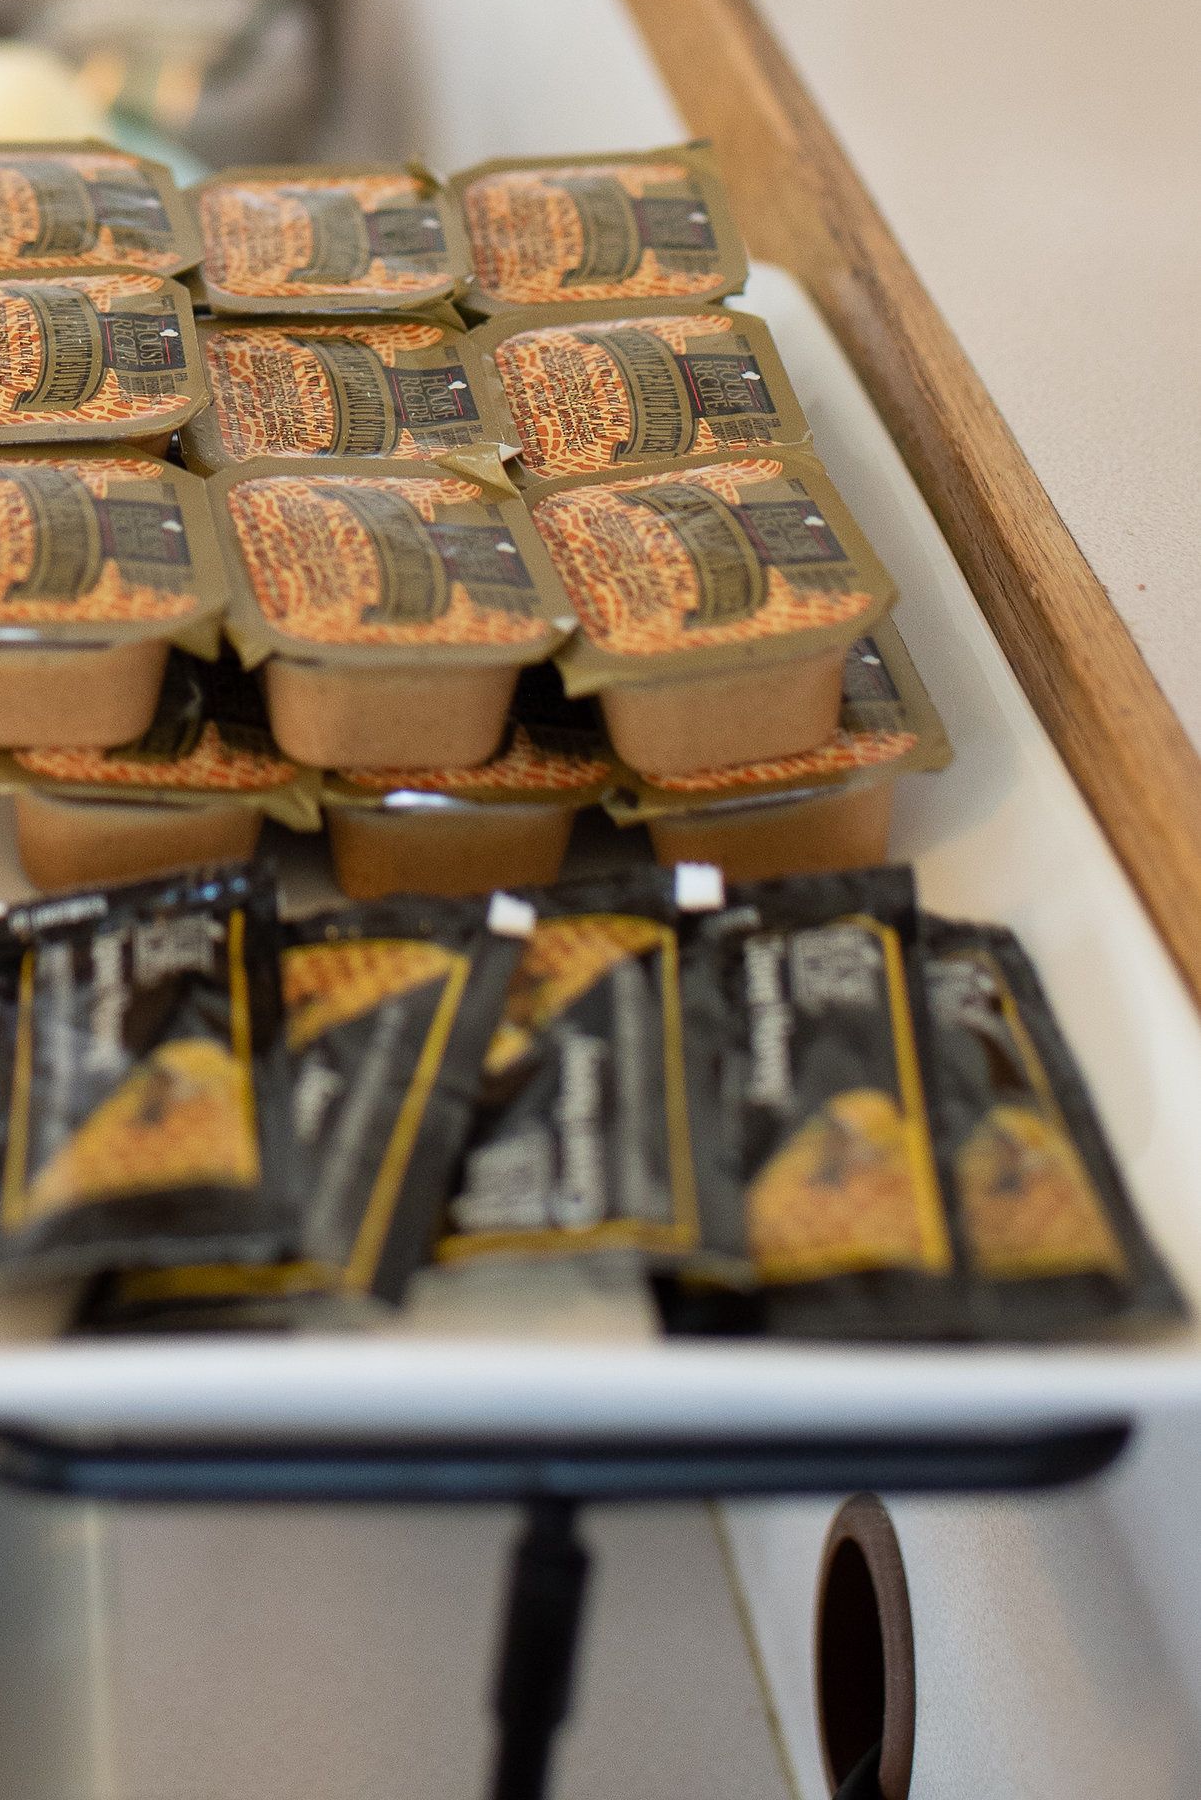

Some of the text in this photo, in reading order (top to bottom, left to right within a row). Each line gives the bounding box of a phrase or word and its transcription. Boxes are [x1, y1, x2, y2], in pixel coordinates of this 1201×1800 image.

[113, 319, 138, 364] RECIPE
[134, 320, 164, 366] HOUSE
[42, 362, 92, 402] BUTTER
[399, 376, 433, 422] RECIPE
[422, 376, 457, 420] HOUSE
[692, 361, 727, 410] RECIPE
[714, 361, 752, 407] HOUSE
[342, 420, 385, 456] BUTTER
[639, 412, 682, 453] BUTTER
